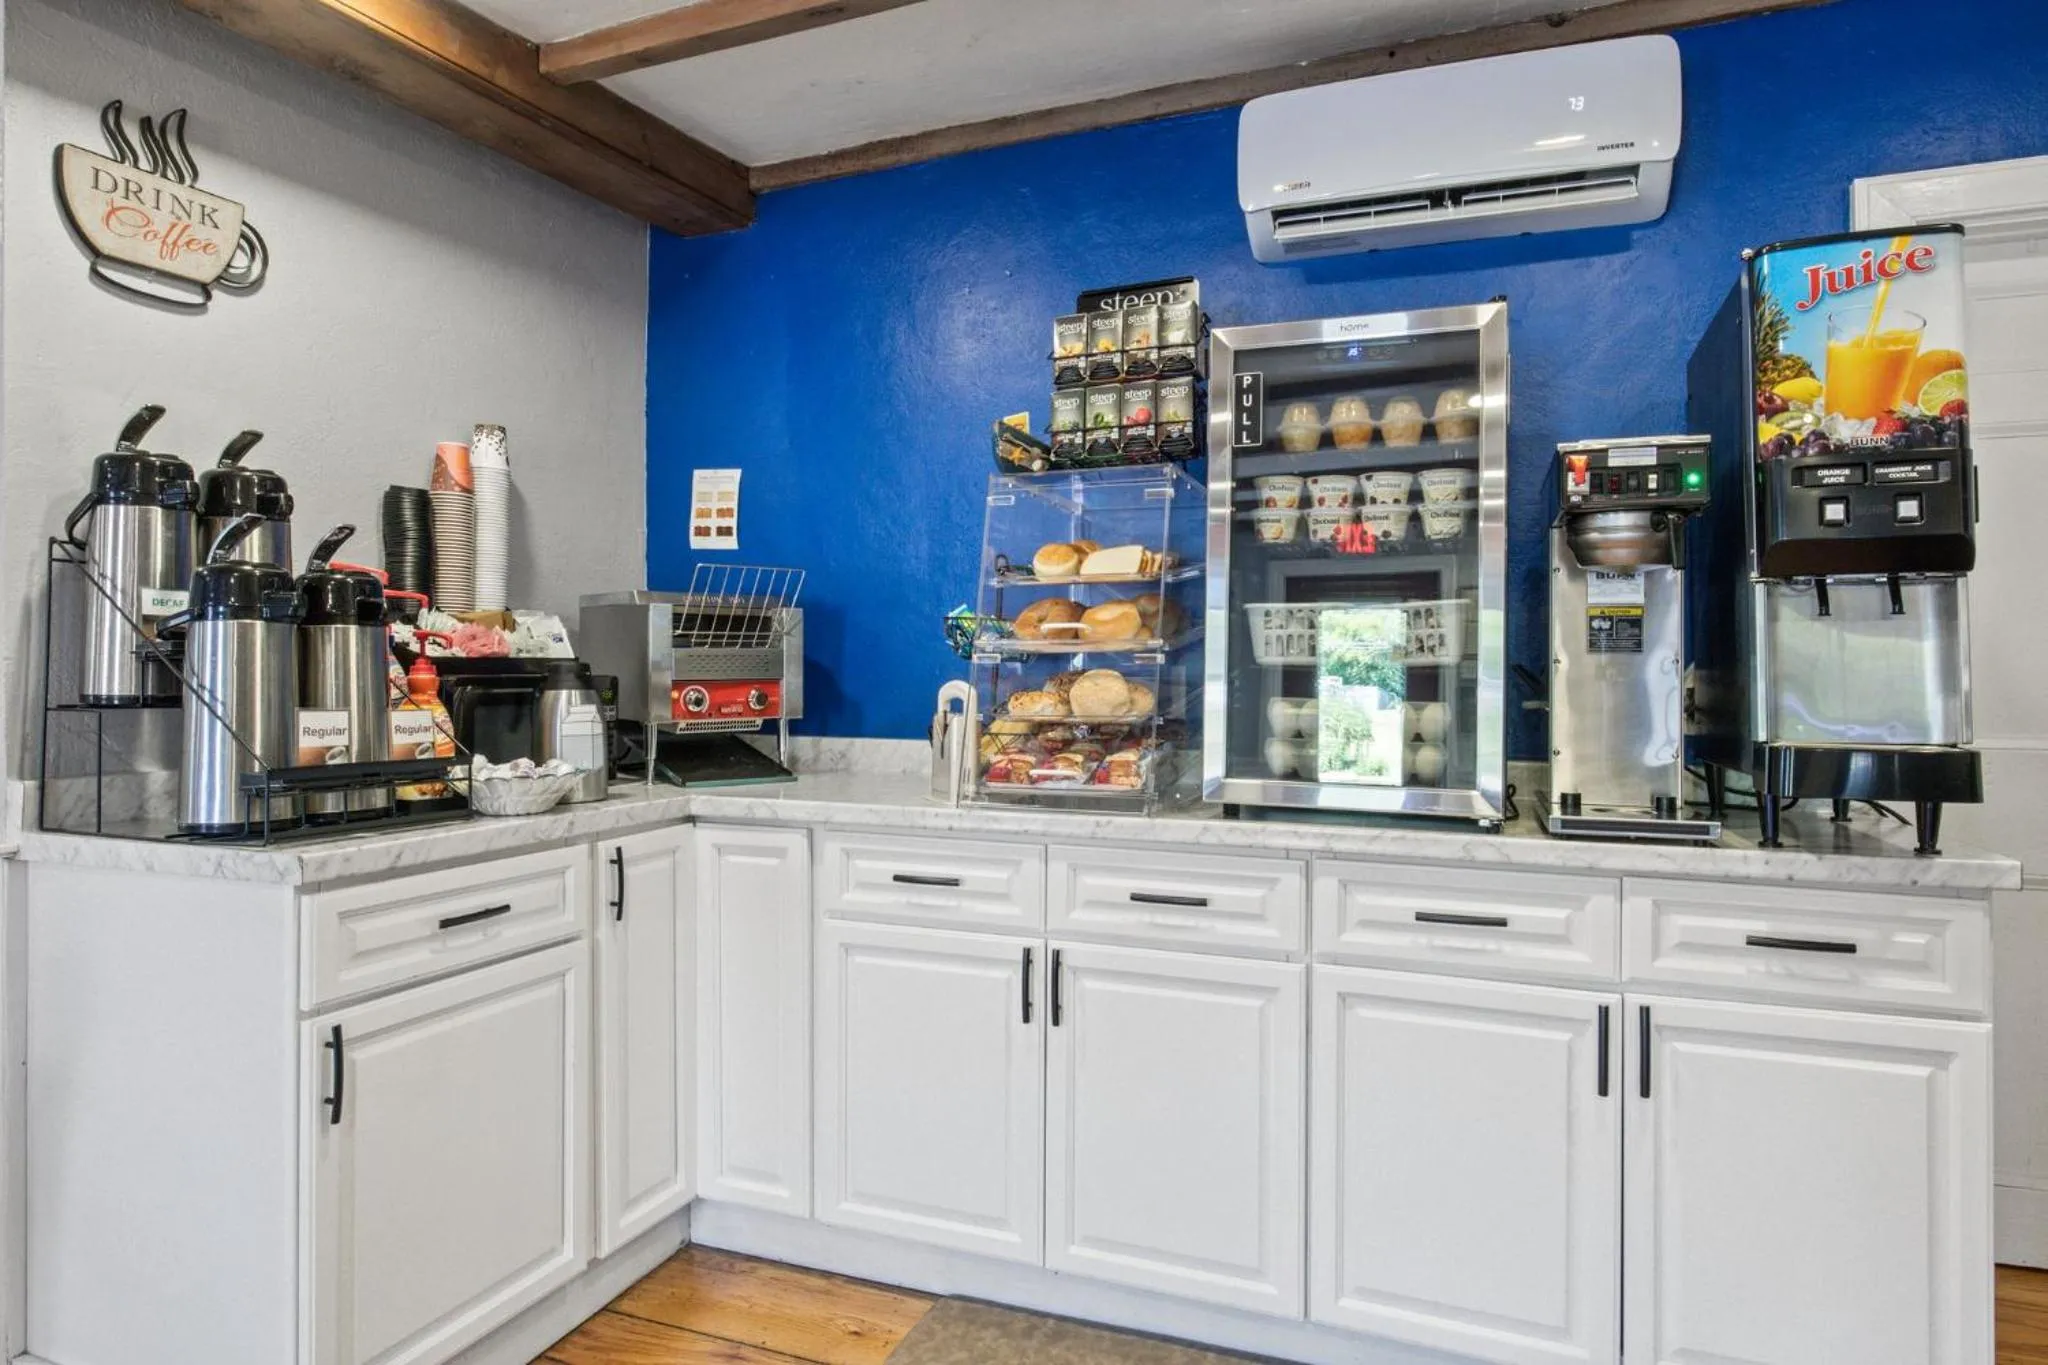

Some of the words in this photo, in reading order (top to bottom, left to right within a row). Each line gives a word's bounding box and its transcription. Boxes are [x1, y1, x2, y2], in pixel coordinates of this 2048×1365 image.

[1567, 96, 1584, 111] 73
[1597, 141, 1634, 151] INVERTER
[91, 166, 220, 230] DRINK
[103, 197, 218, 261] Coffee
[1796, 245, 1935, 311] Juice
[1124, 388, 1152, 401] steep
[1161, 385, 1189, 397] steep
[1090, 392, 1117, 405] steep
[1242, 375, 1253, 444] PULL
[1850, 436, 1889, 447] BUNN
[1817, 468, 1851, 476] ORANGE
[152, 598, 185, 606] DECAF
[302, 726, 348, 739] Regular
[394, 724, 432, 737] Regular
